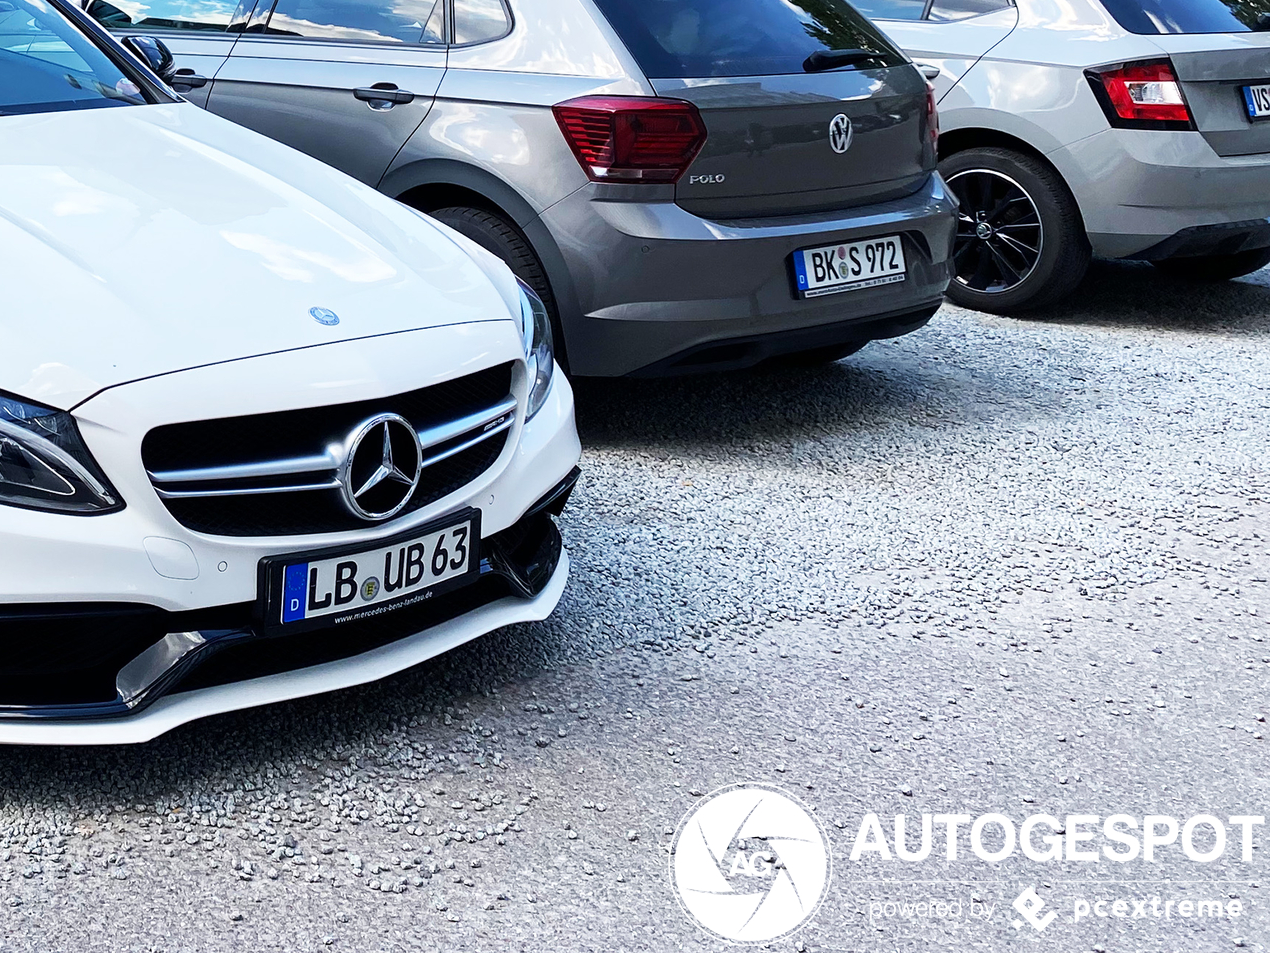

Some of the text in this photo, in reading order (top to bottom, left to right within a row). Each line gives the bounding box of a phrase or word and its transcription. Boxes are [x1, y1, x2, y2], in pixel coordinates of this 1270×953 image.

[1252, 88, 1270, 112] VS
[689, 174, 726, 185] POLO
[812, 241, 899, 282] BK S 972
[799, 275, 805, 284] D
[308, 526, 468, 611] LB UB 63
[291, 599, 299, 611] D
[334, 591, 433, 624] www.mercedes-benz-landau.de
